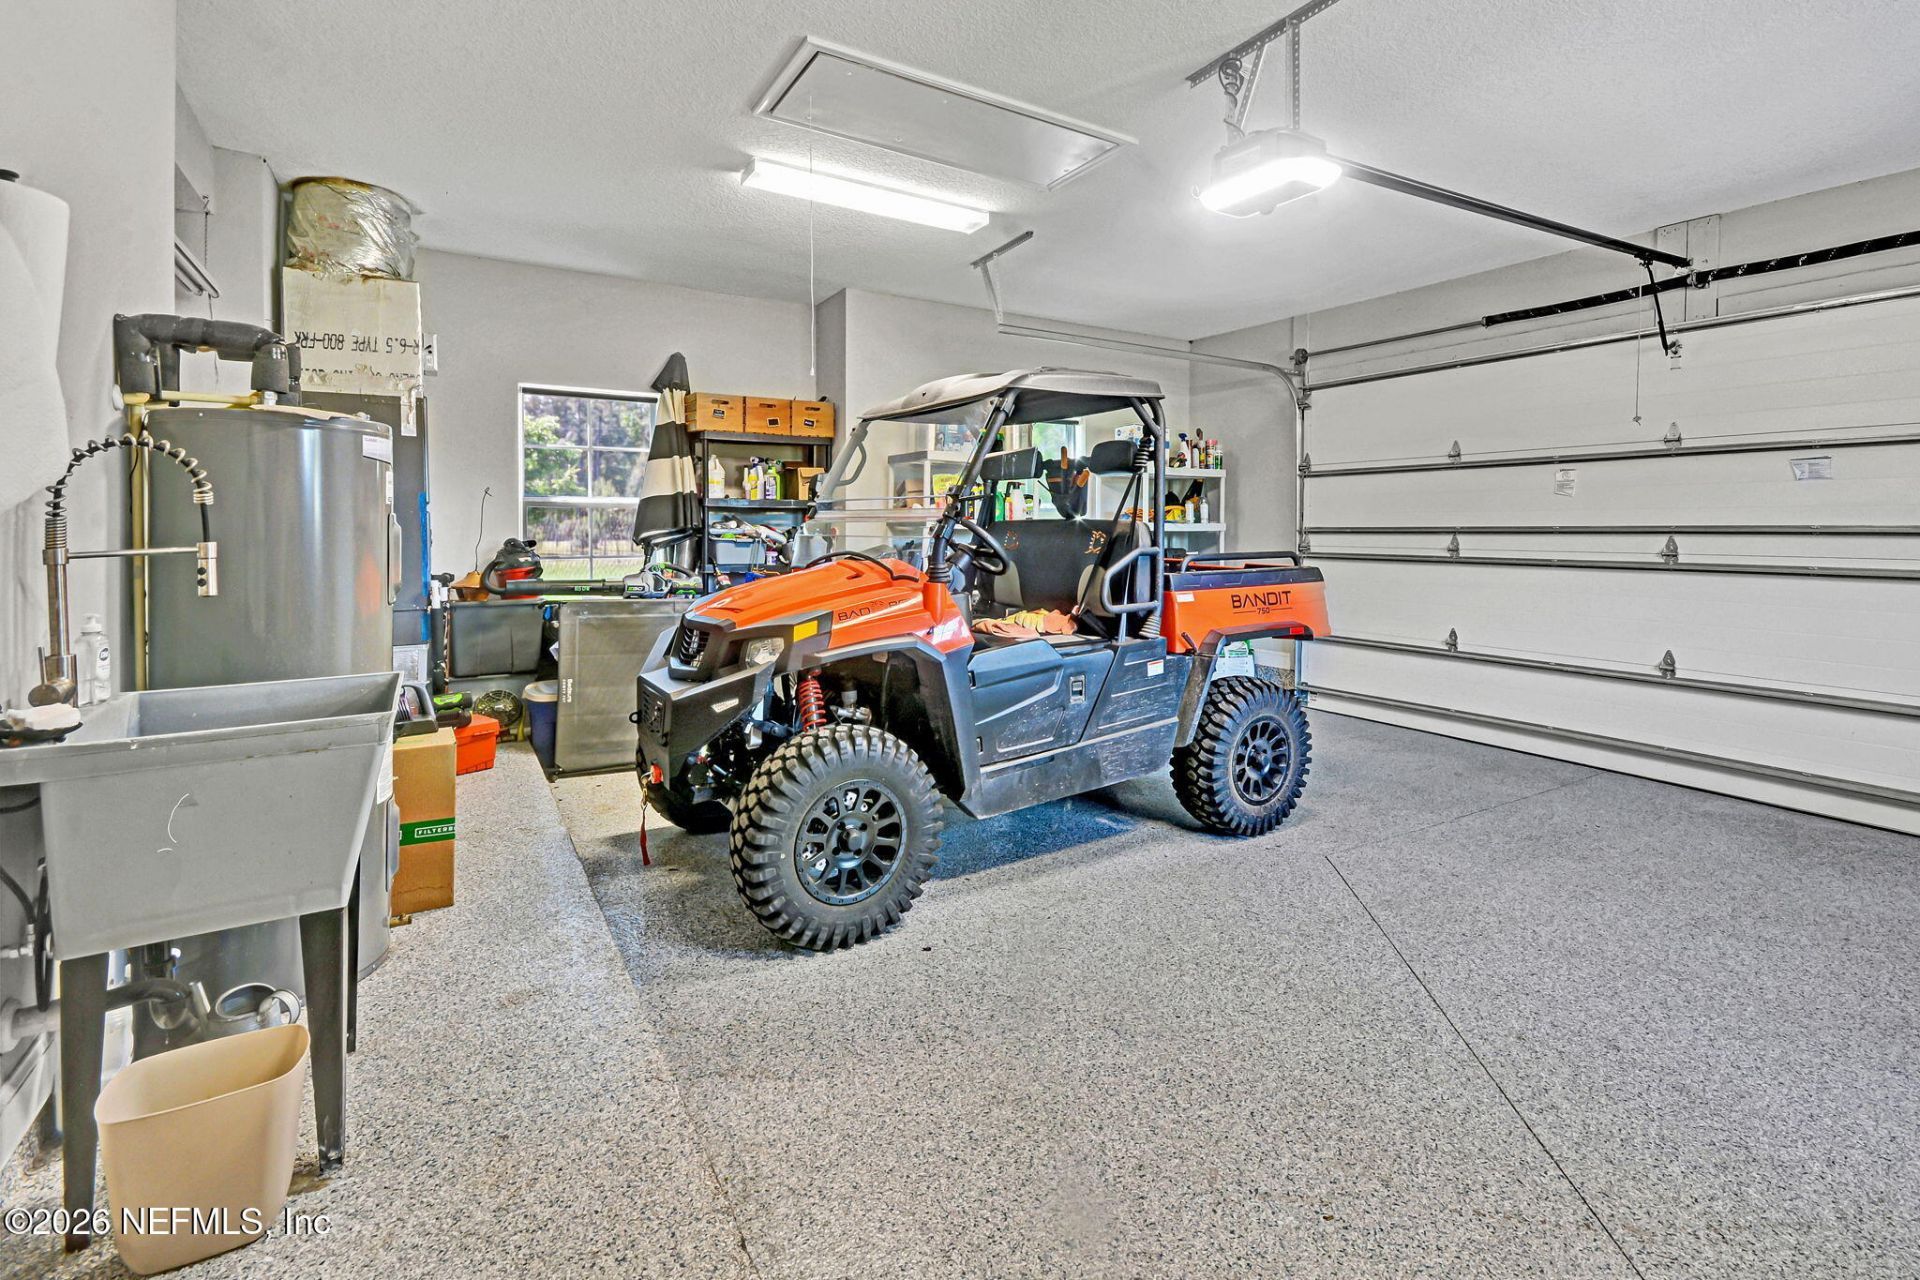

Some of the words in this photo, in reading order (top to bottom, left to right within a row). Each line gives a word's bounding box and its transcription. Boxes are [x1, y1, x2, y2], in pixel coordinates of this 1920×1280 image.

[351, 335, 378, 353] TYPE
[1231, 591, 1291, 609] BANDIT
[418, 825, 456, 835] FILTERB
